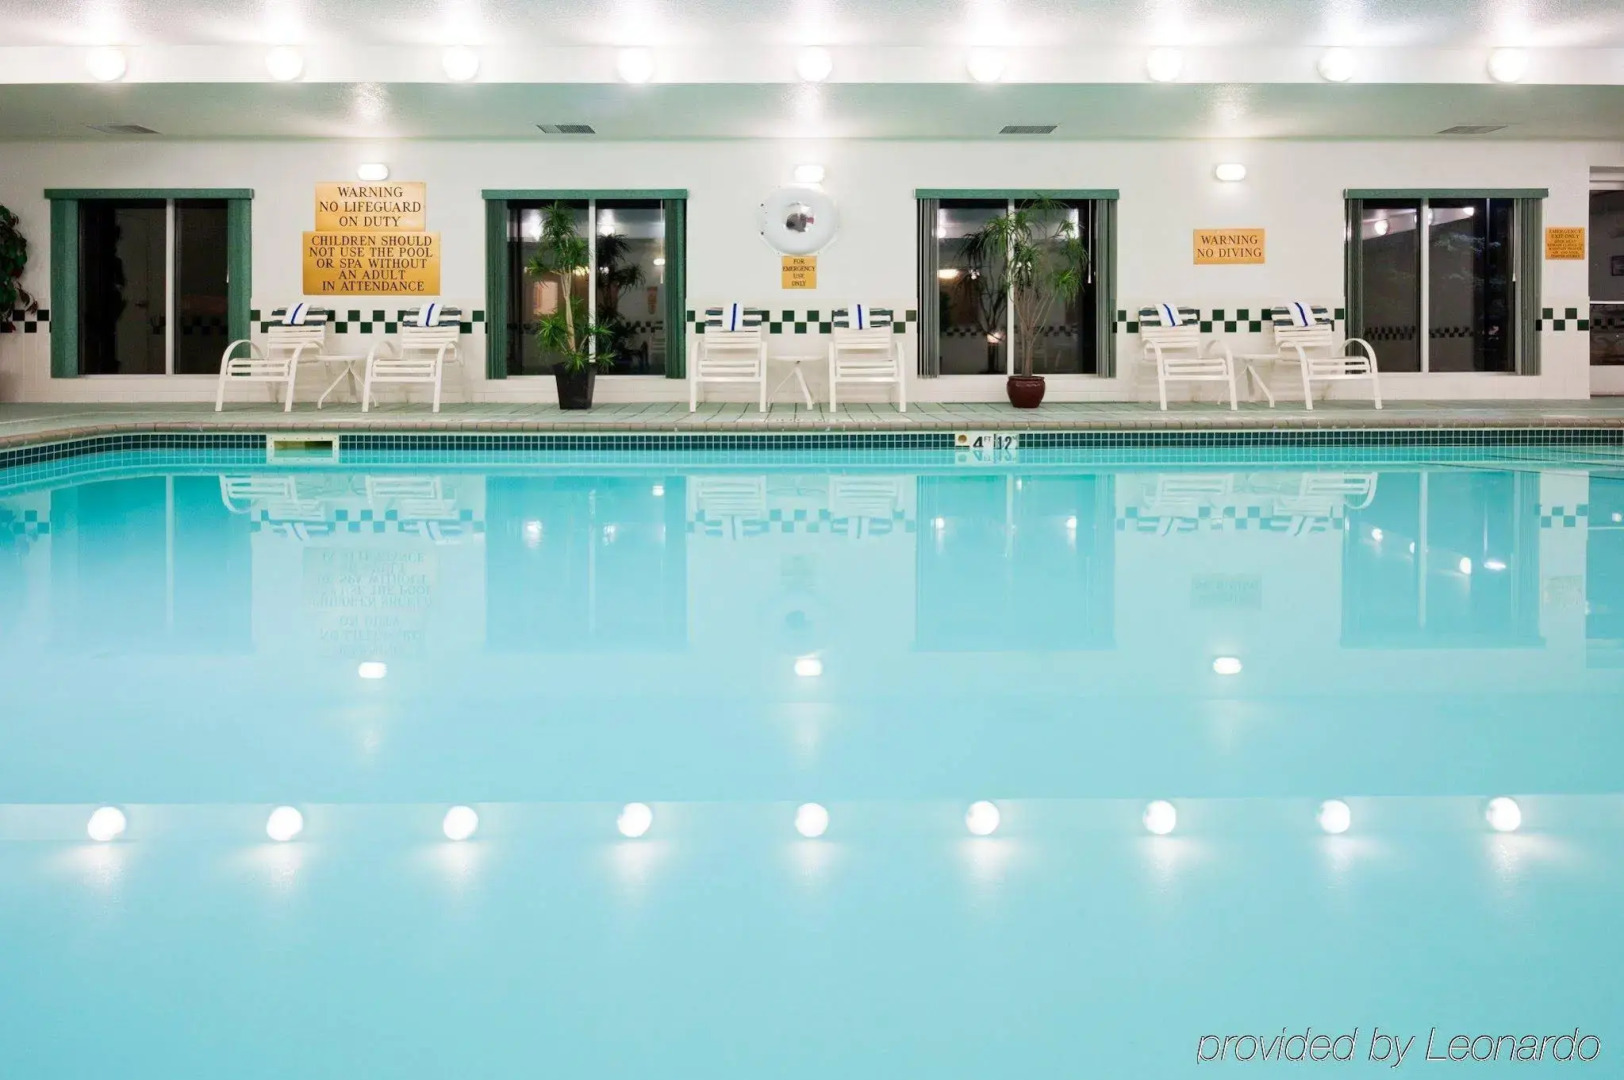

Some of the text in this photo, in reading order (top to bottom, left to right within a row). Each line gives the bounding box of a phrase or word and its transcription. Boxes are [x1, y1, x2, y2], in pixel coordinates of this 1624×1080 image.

[337, 186, 403, 197] WARNING
[320, 202, 421, 212] NO LIFEGUARD
[339, 216, 401, 227] ON DUTY
[311, 236, 432, 246] CHILDREN SHOULD
[1201, 235, 1258, 244] WARNING
[309, 247, 433, 257] NOT USE THE POOL
[1197, 248, 1262, 258] NO DIVING
[316, 259, 427, 269] OR SPA WITHOUT
[338, 270, 406, 280] AN ADULT
[322, 281, 424, 291] IN ATTENDANCE
